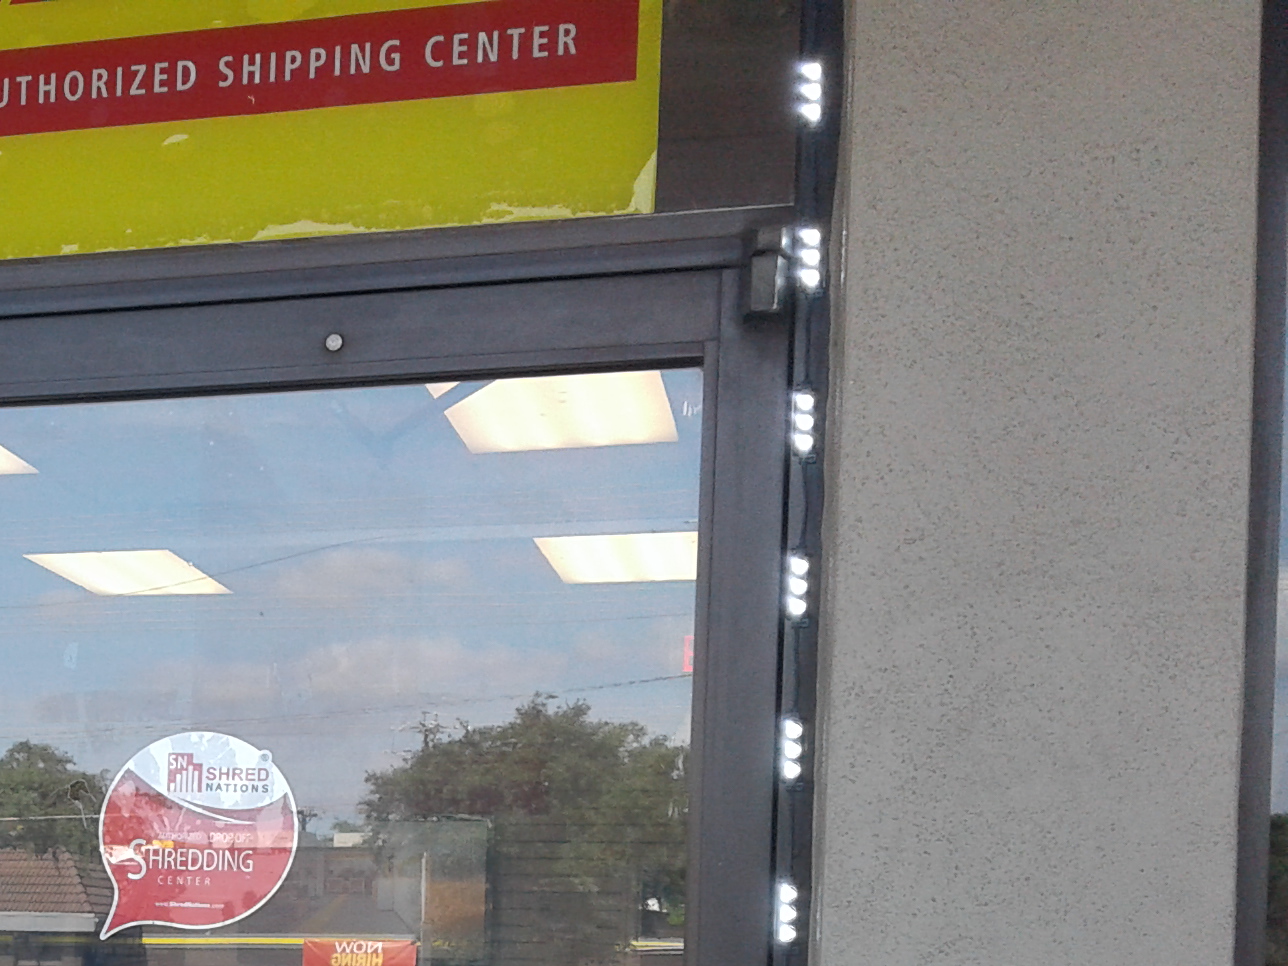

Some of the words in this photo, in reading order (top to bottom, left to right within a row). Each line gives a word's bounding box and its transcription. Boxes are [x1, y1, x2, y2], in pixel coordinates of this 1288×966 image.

[216, 38, 402, 90] SHIPPING
[423, 22, 580, 72] CENTER
[205, 766, 270, 782] SHRED
[205, 783, 270, 794] NATIONS
[127, 838, 254, 880] SHREDDING
[157, 875, 211, 886] CENTER
